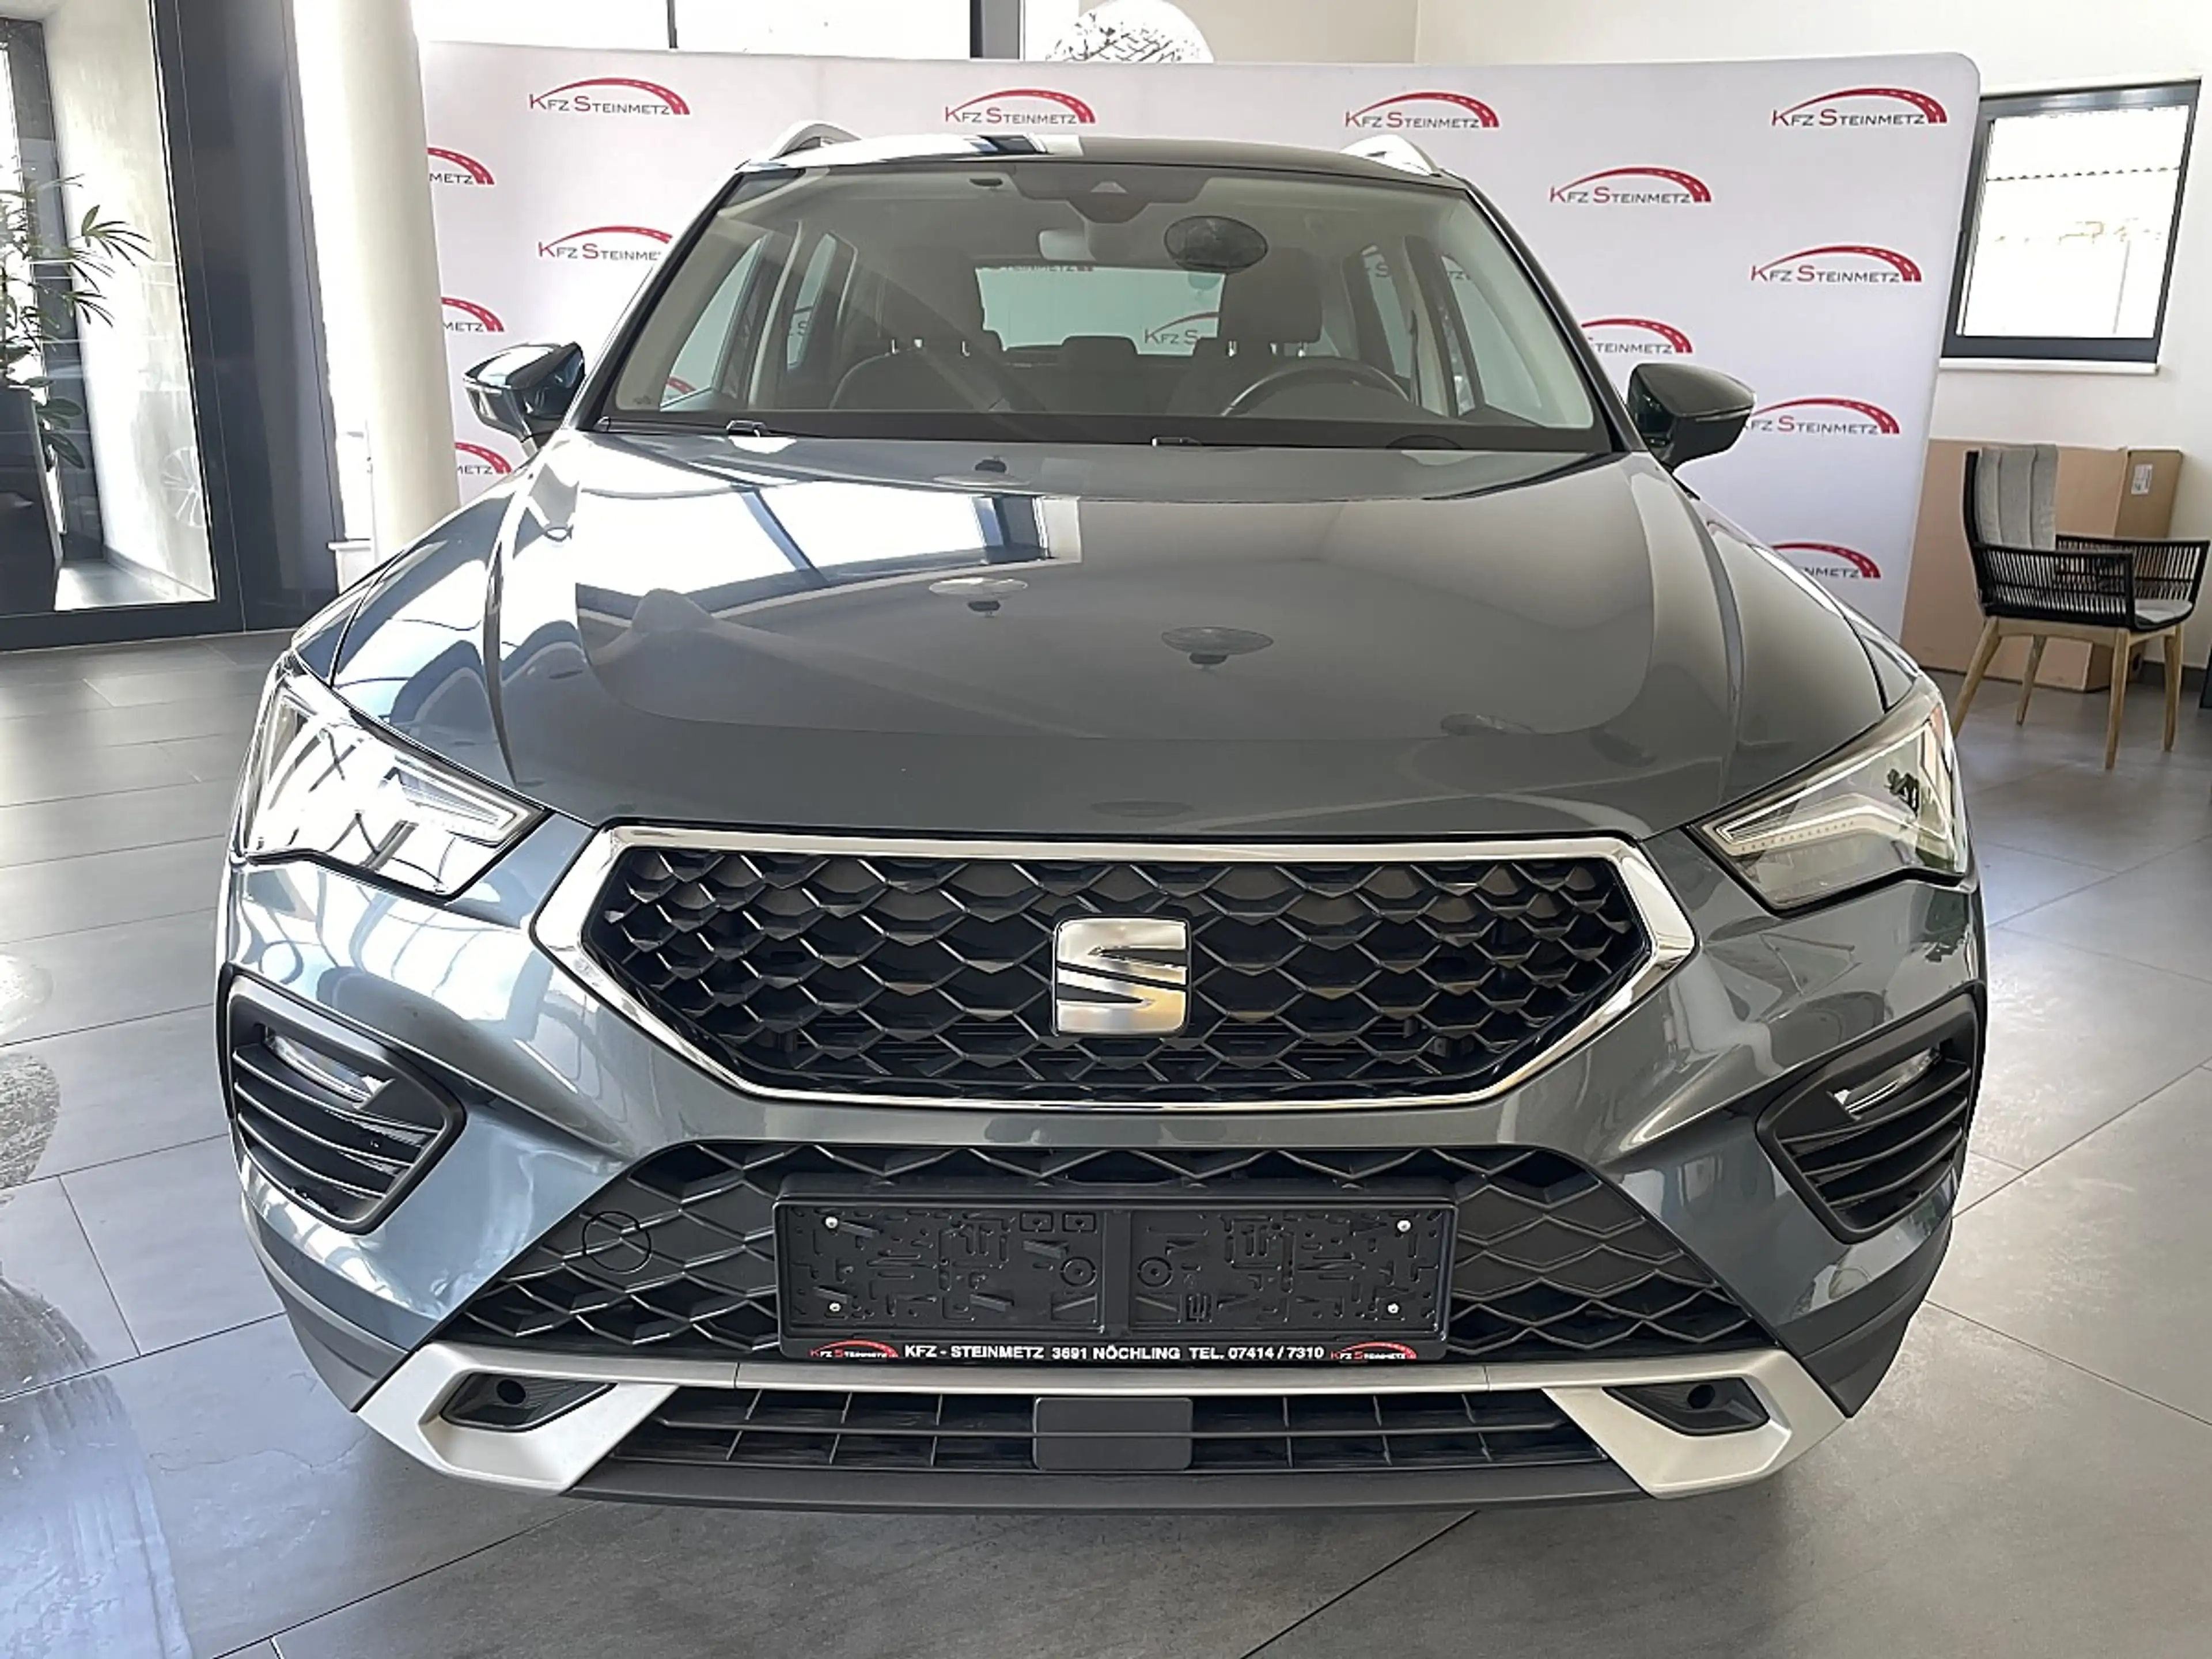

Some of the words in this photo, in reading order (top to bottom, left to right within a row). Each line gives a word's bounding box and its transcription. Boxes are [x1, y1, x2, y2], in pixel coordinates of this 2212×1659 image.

[574, 96, 670, 115] STEINMETZ
[986, 107, 1077, 124] STEINMETZ
[1387, 112, 1479, 128] STEINMETZ
[1819, 109, 1925, 126] STEINMETZ
[1593, 187, 1691, 204] STEINMETZ
[582, 243, 661, 260] STEINME
[1797, 265, 1900, 283] STEINMETZ
[1589, 339, 1672, 354] TEINMETZ
[1778, 415, 1879, 435] STEINMETZ
[905, 1344, 937, 1358] KFZ
[951, 1345, 1044, 1359] STEINMETZ
[1052, 1346, 1087, 1360] 3691
[1093, 1344, 1181, 1360] NÖCHLING
[1189, 1347, 1225, 1360] TEL.
